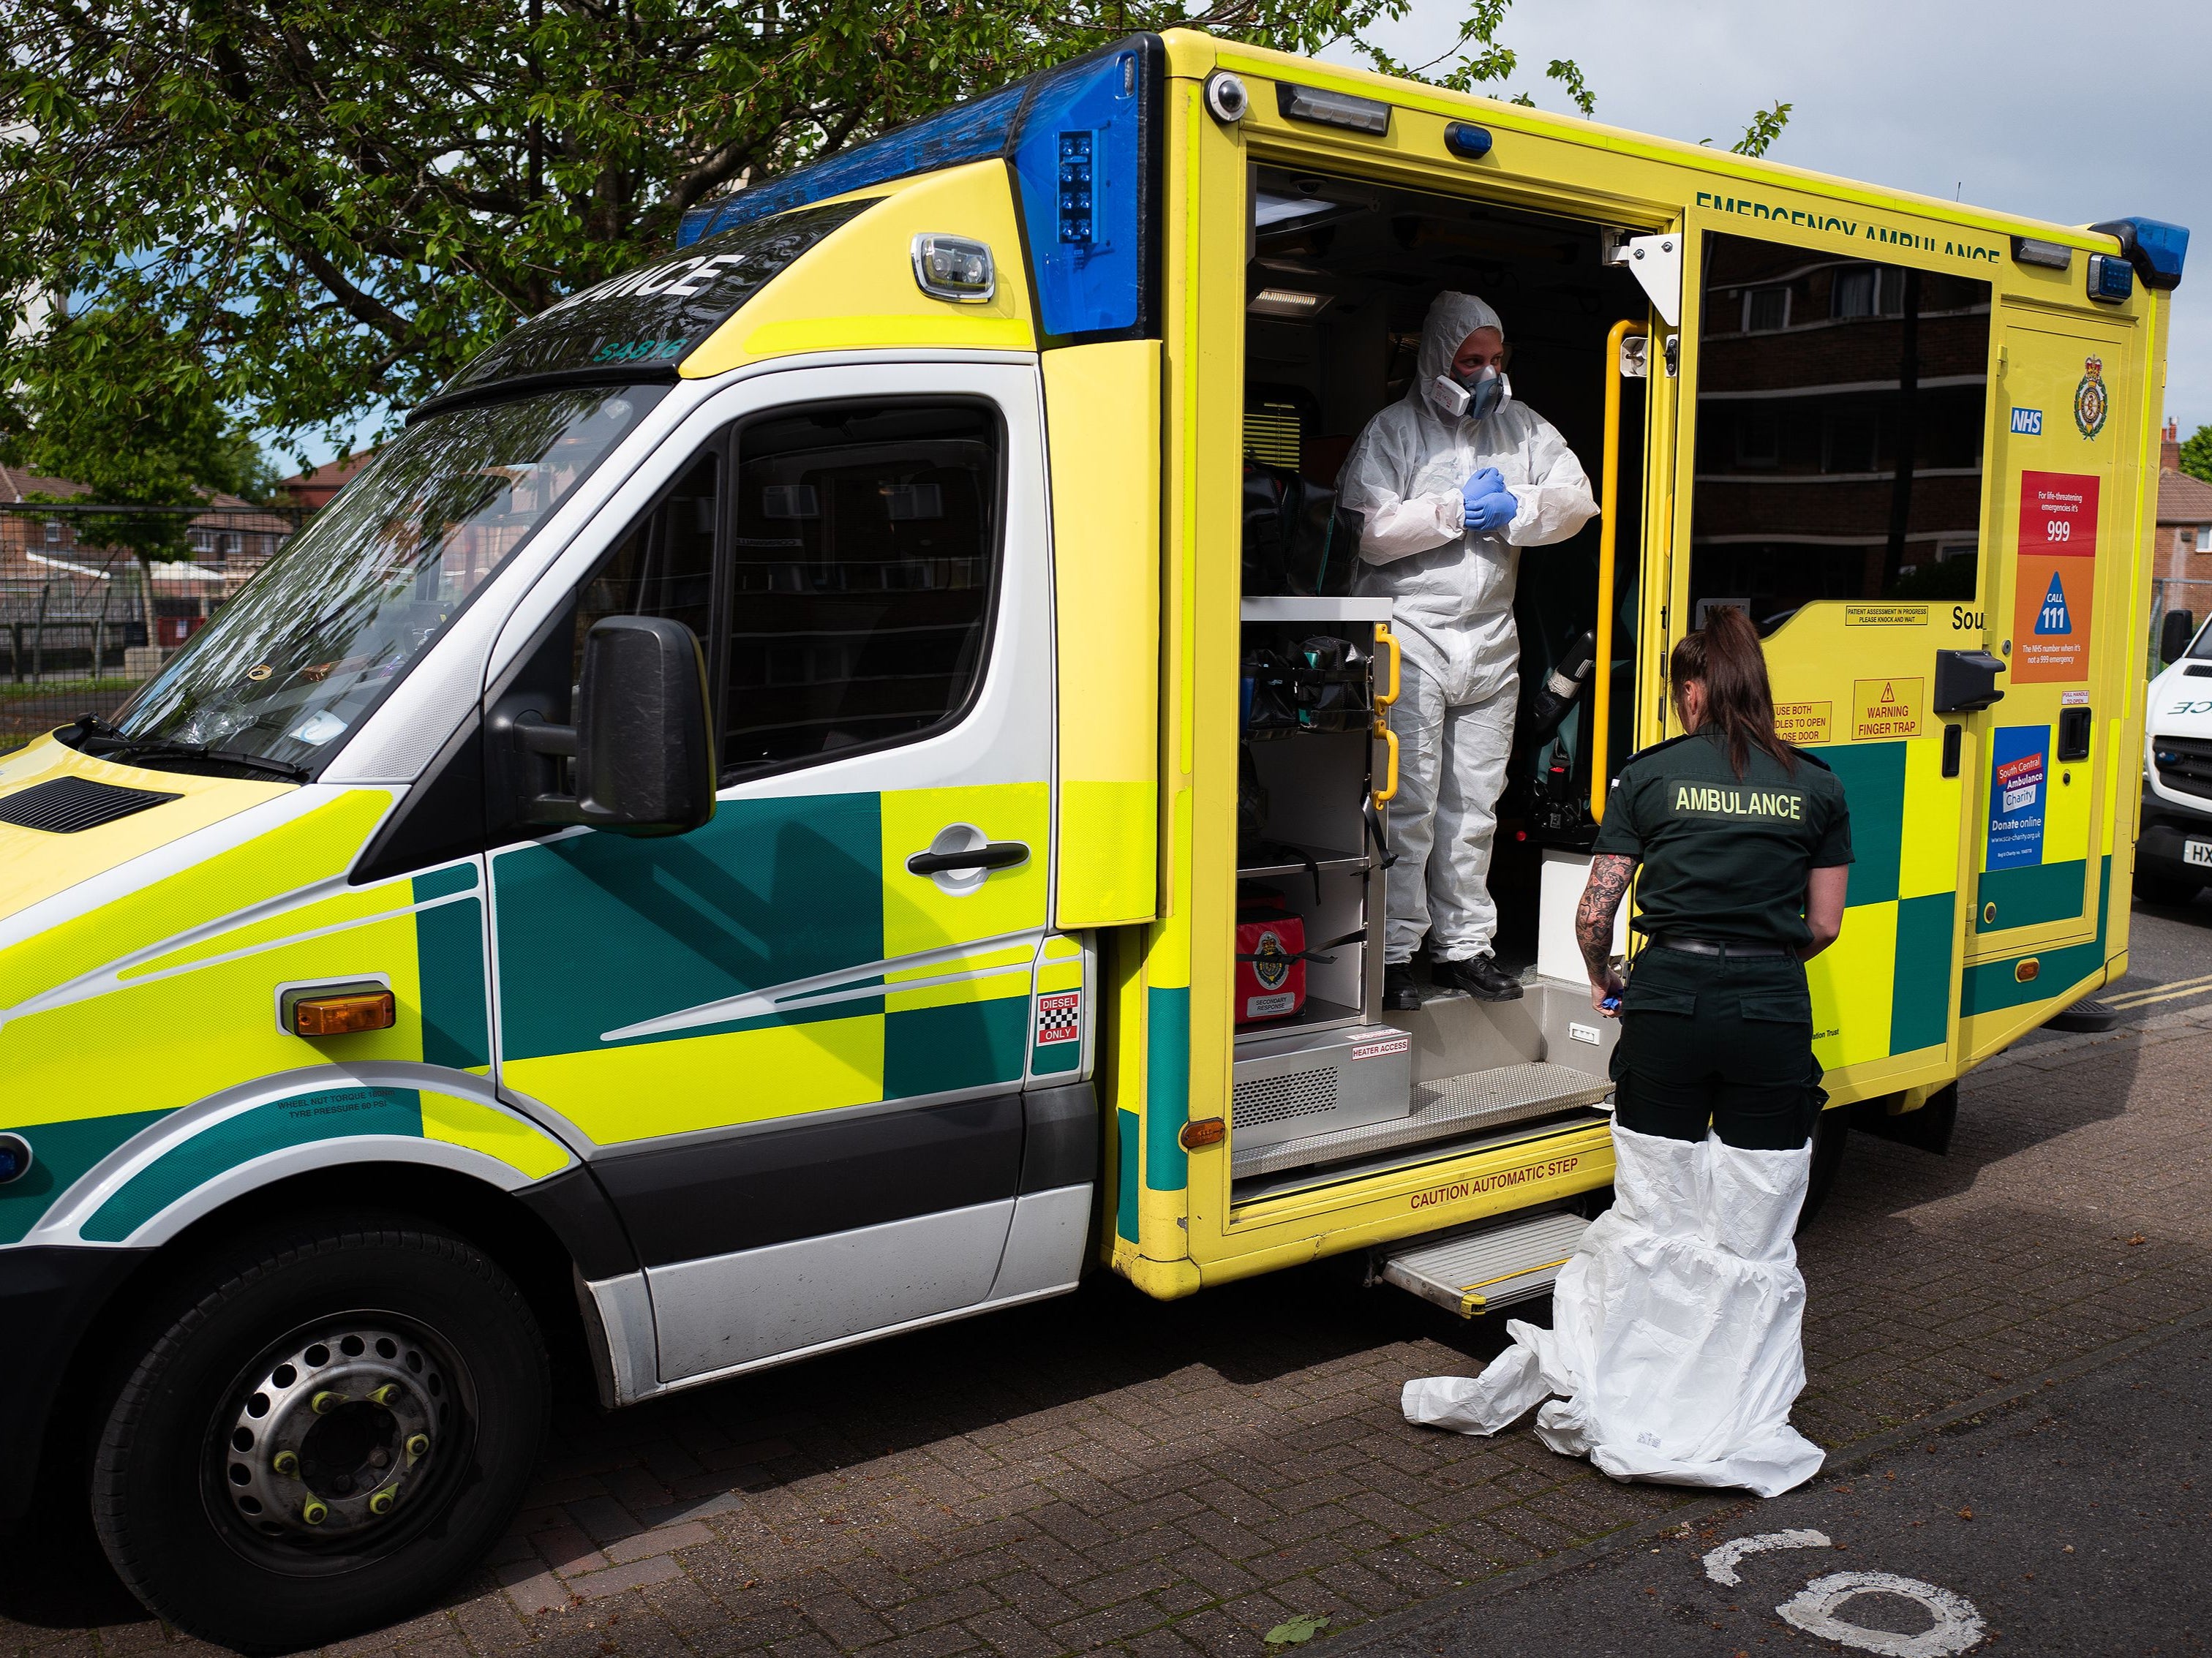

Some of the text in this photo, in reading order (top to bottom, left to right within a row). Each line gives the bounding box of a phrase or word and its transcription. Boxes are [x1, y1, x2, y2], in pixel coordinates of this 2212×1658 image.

[2012, 410, 2041, 433] NHS
[2038, 491, 2083, 503] For life-threatening
[2041, 503, 2071, 513] emergencies
[2047, 521, 2070, 542] 999
[2047, 593, 2063, 603] CALL
[1952, 606, 1985, 630] Sou
[2042, 607, 2064, 628] 111
[2023, 644, 2031, 652] The
[2042, 644, 2060, 652] number
[1776, 706, 1812, 715] USE BOTH
[1867, 706, 1908, 719] WARNING
[1795, 718, 1805, 728] TO
[1807, 717, 1826, 727] OPEN
[1859, 721, 1916, 736] FINGER TRAP
[1799, 731, 1818, 740] DOOR
[1999, 755, 2040, 780] South Central
[2006, 772, 2043, 790] Ambulance
[1675, 787, 1802, 820] AMBULANCE
[2006, 789, 2034, 806] Charity
[1992, 815, 2042, 832] Donate online
[1042, 997, 1075, 1009] DIESEL
[1256, 997, 1287, 1006] SECONDARY
[1257, 1003, 1285, 1011] RESPONSE
[1045, 1028, 1071, 1040] ONLY
[1812, 1028, 1839, 1040] ation Trust
[1353, 1041, 1407, 1058] HEATER ACCESS
[277, 1099, 309, 1110] WHEEL
[311, 1096, 328, 1105] NUT
[330, 1092, 366, 1103] TORQUE
[288, 1099, 387, 1119] TYRE PRESSURE 60 PSI
[1410, 1157, 1578, 1209] CAUTION AUTOMATIC STEP
